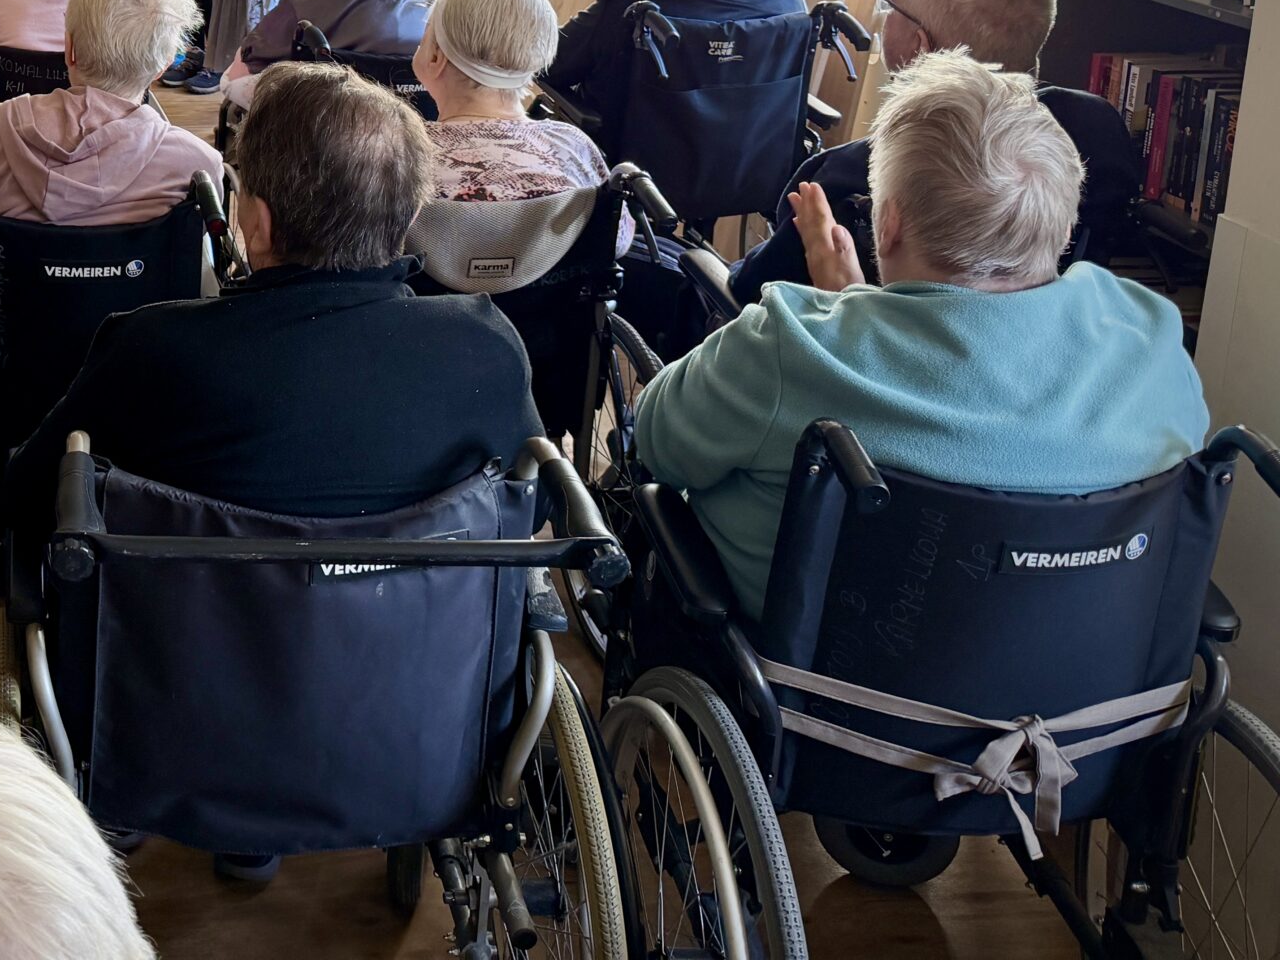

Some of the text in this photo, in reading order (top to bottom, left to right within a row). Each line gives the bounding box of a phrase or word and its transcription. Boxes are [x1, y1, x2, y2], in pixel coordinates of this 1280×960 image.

[708, 48, 732, 56] CARE
[396, 84, 426, 93] VERM
[44, 265, 122, 278] VERMEIREN
[1010, 545, 1122, 569] VERMEIREN
